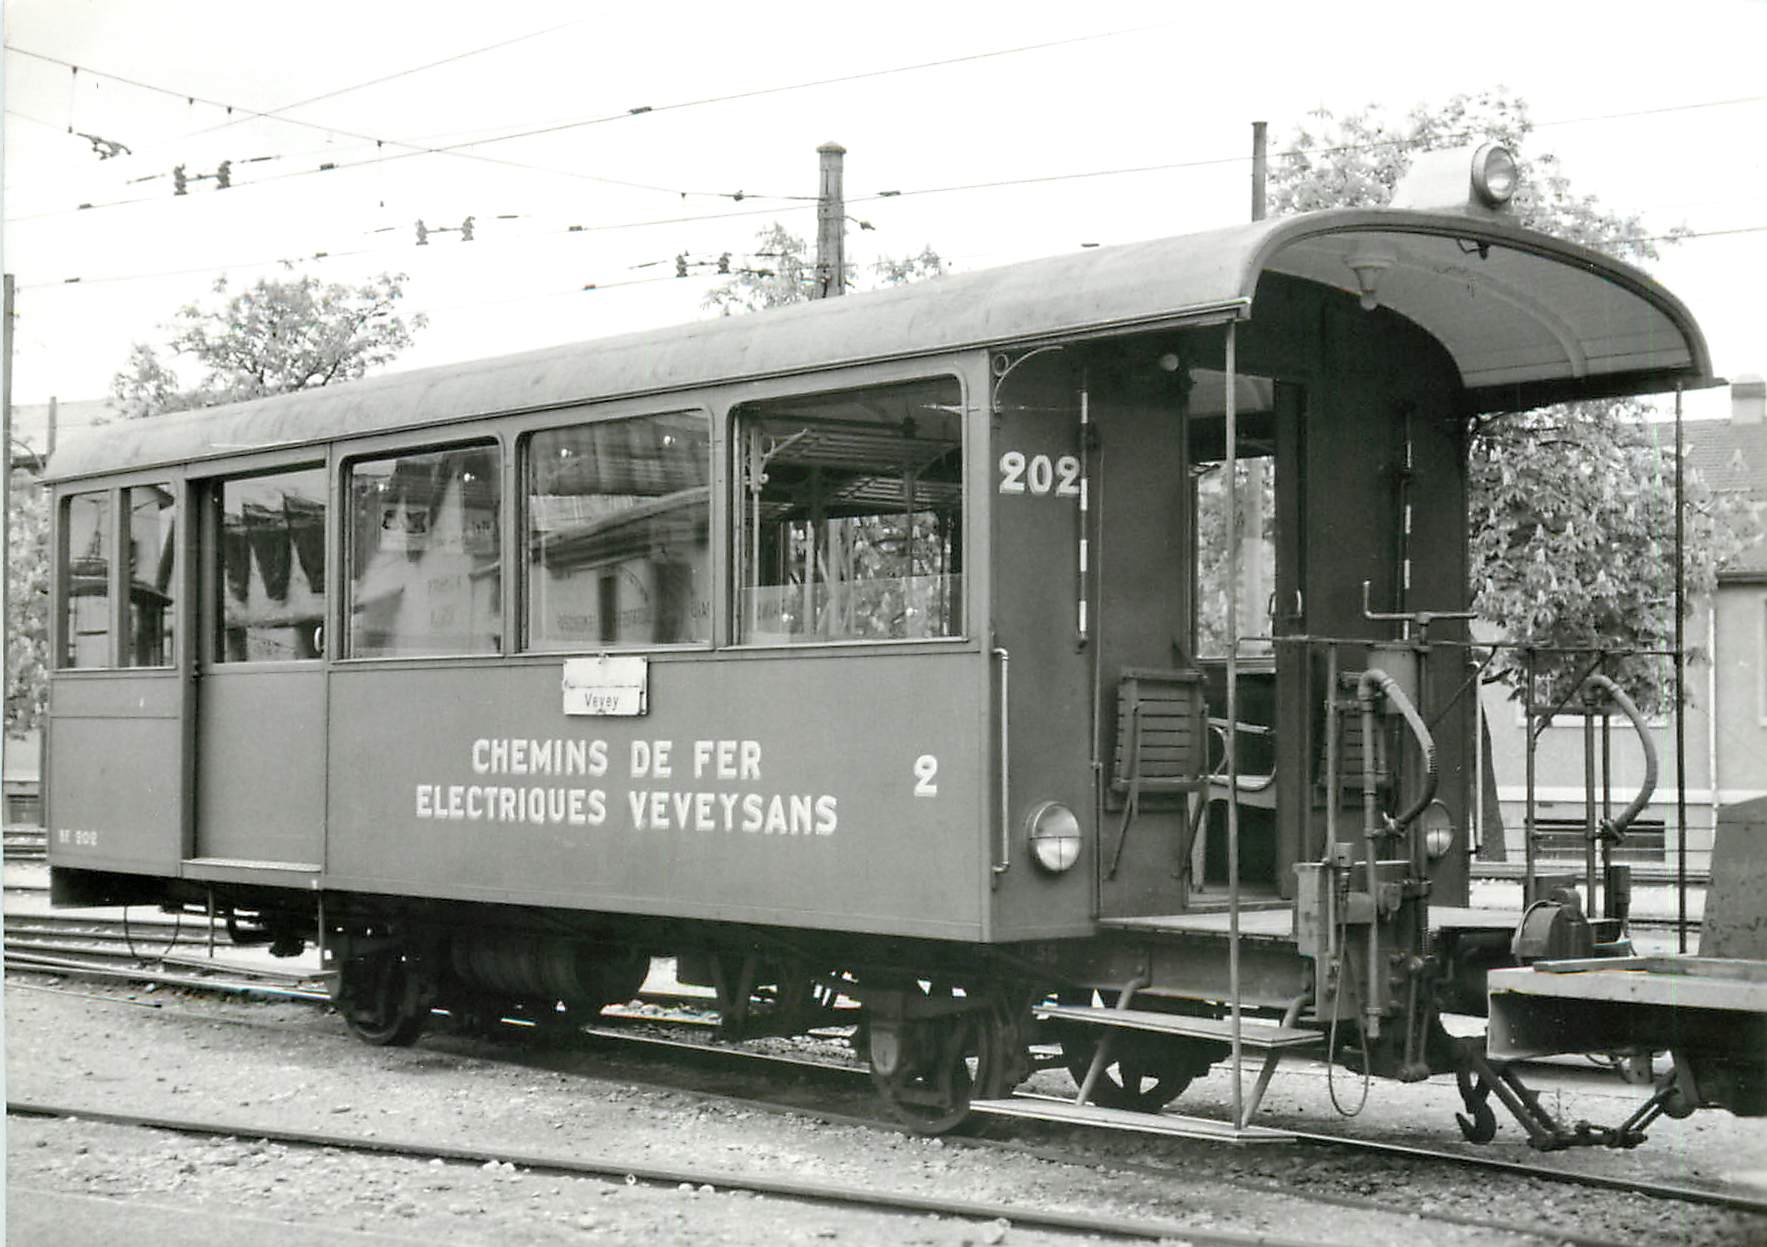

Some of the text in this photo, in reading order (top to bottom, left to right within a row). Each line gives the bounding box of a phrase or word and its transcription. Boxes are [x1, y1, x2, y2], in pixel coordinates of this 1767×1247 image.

[999, 451, 1080, 497] 202
[585, 692, 619, 711] Vevey
[472, 739, 762, 779] CHEMINS DE FER
[914, 754, 938, 797] 2
[416, 785, 838, 835] ELECTRIQUES VEVEYSANS
